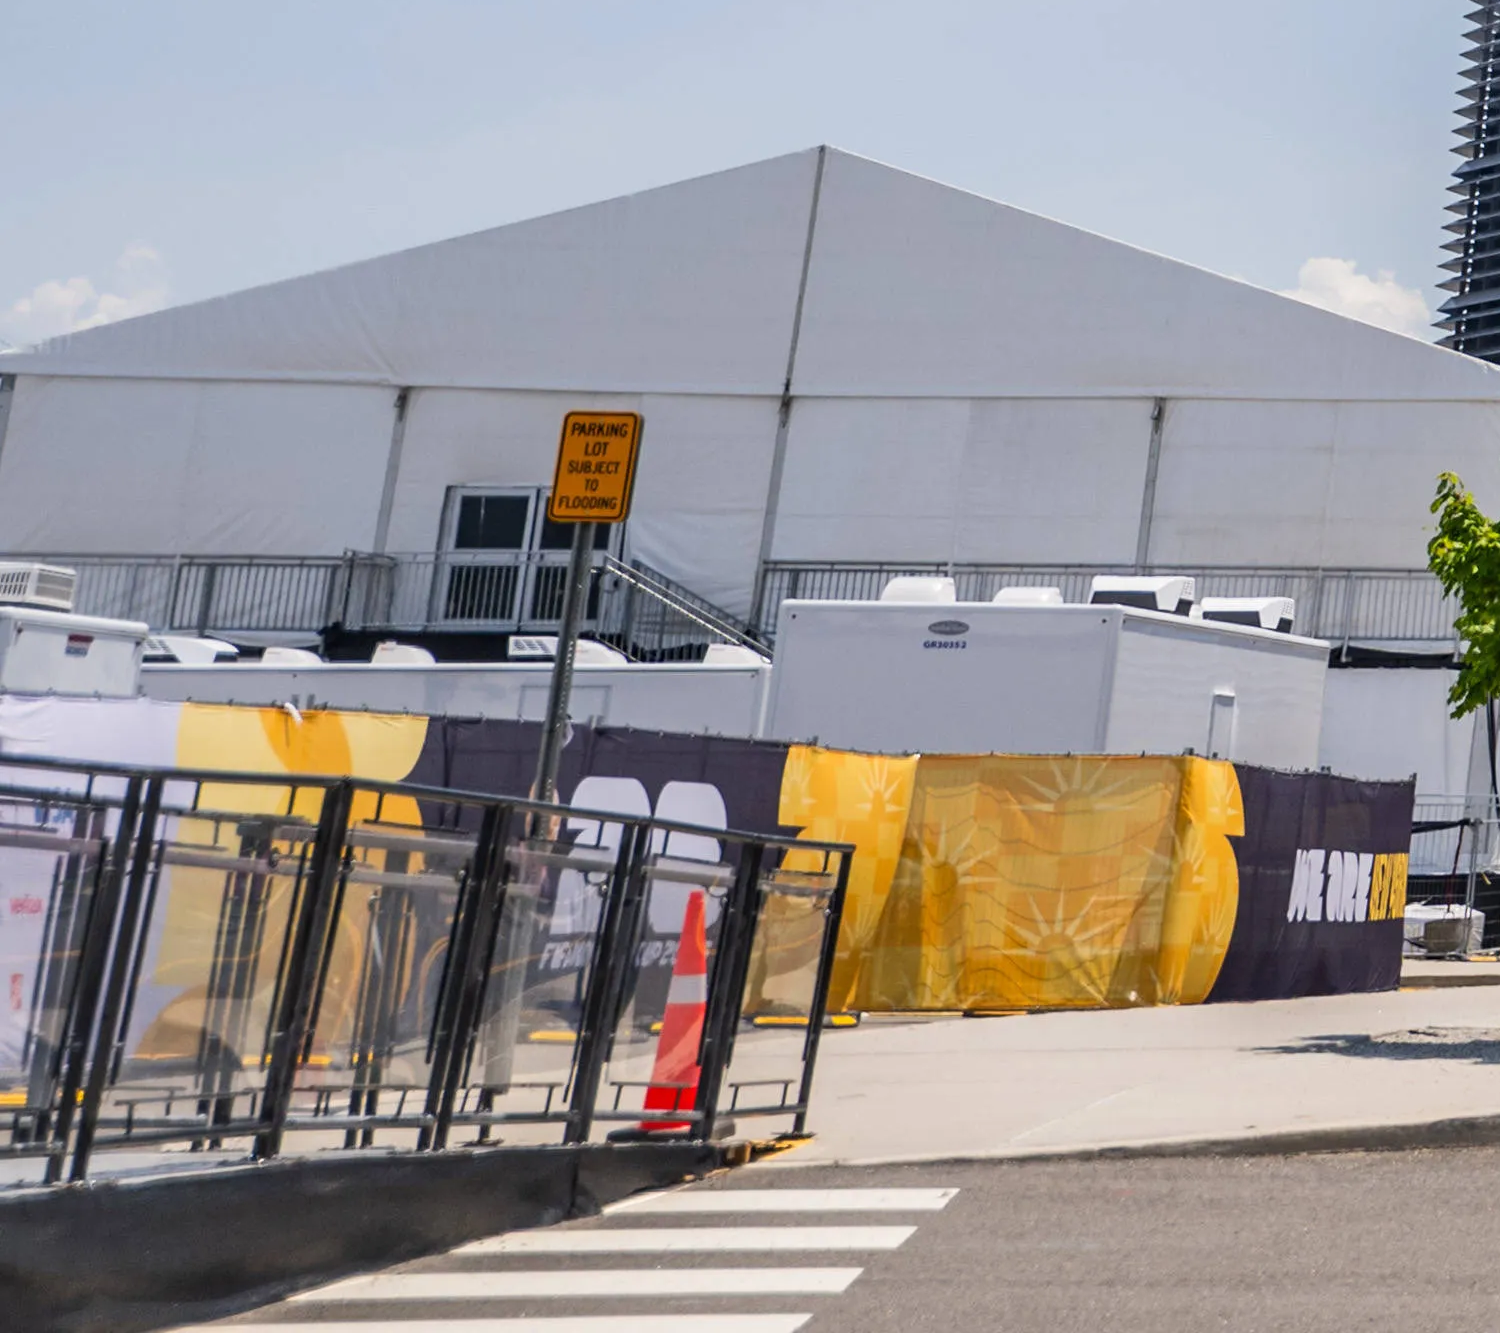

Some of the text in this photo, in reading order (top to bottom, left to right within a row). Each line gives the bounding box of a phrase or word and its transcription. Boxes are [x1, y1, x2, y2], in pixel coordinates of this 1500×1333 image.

[571, 422, 629, 438] PARKING
[584, 442, 610, 457] LOT
[567, 460, 621, 475] SUBJECT
[584, 478, 600, 492] TO
[558, 496, 619, 510] FLOODING
